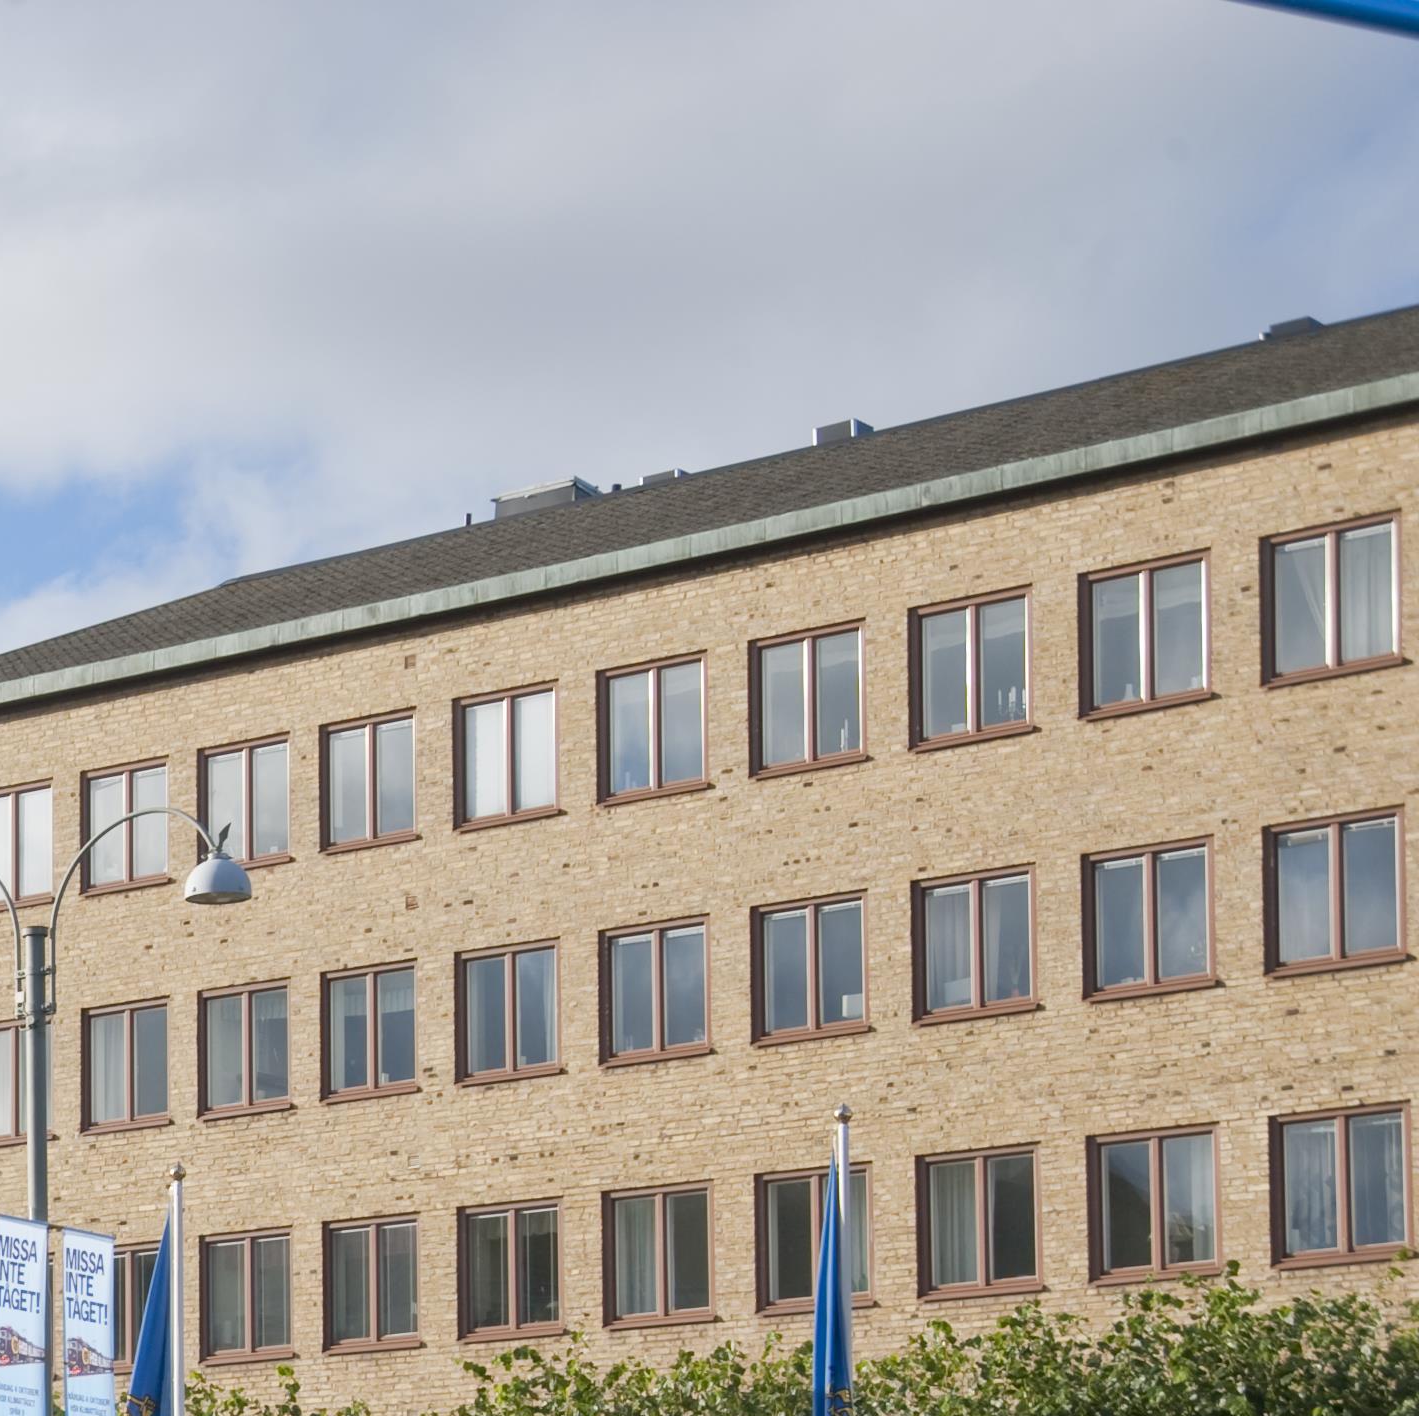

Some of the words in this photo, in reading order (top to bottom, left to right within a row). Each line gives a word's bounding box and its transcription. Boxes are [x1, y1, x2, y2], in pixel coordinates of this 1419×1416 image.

[65, 1246, 105, 1276] MISSA
[65, 1270, 94, 1298] INTE
[65, 1293, 108, 1326] TÅGET!
